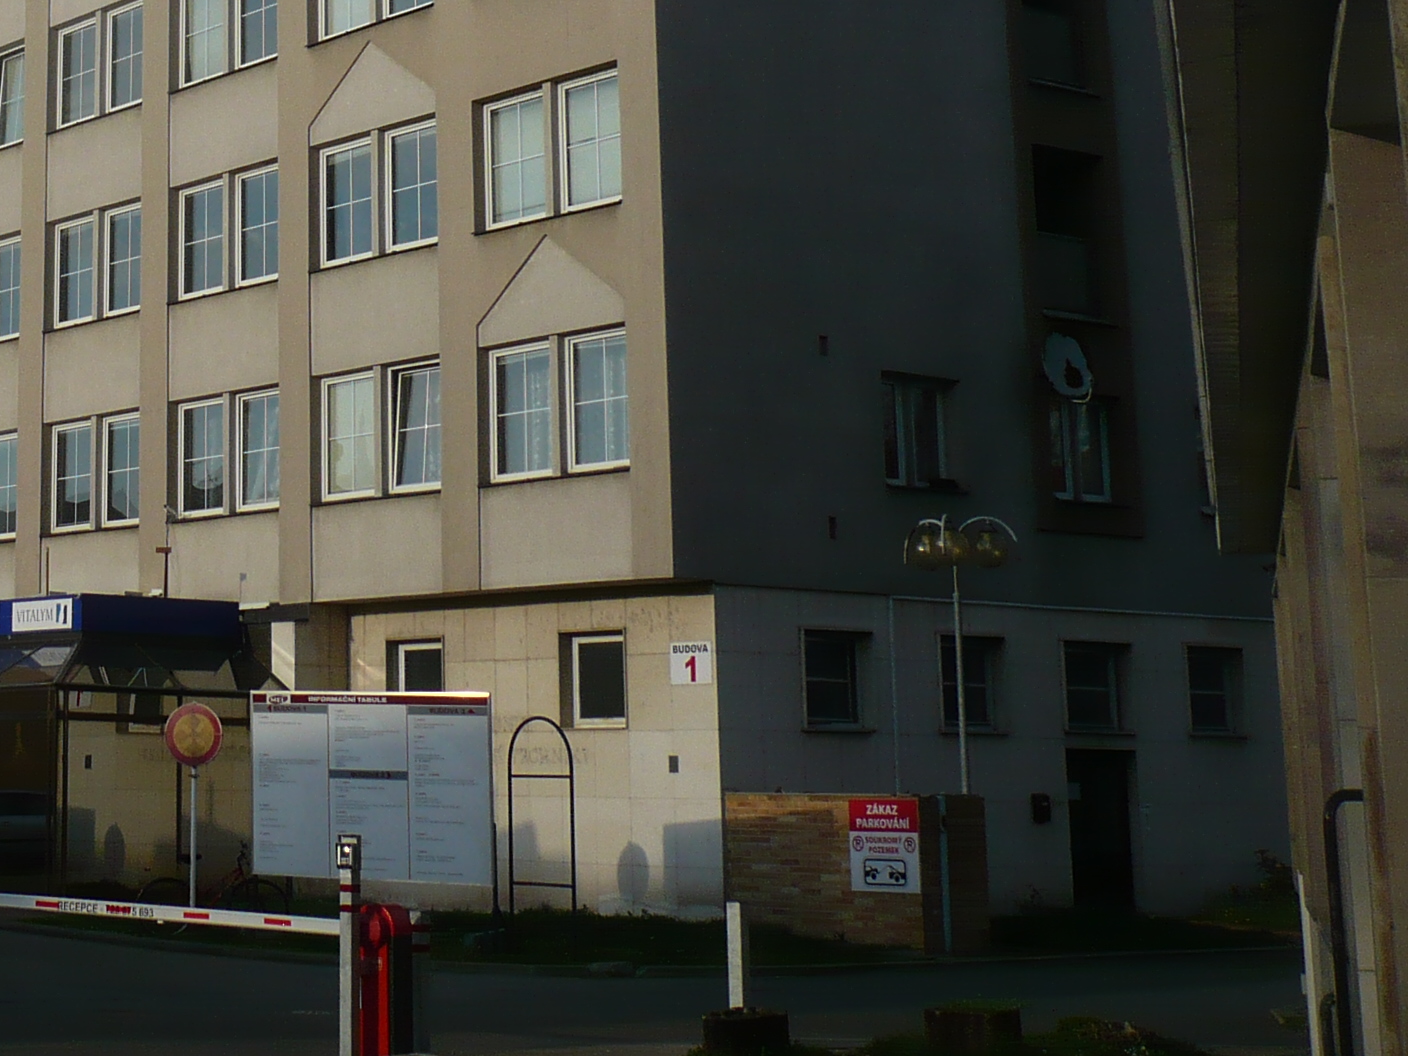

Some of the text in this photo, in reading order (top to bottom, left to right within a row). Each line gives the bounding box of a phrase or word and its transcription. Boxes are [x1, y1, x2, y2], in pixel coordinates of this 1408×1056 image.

[17, 608, 53, 623] VITALYM
[672, 644, 708, 654] BUDOVA
[685, 655, 696, 683] 1
[356, 696, 387, 704] TABULE
[865, 802, 899, 815] ZÁKAZ
[855, 817, 910, 830] PARKOVÁNÍ
[869, 846, 899, 854] POZEMEK
[59, 901, 98, 913] RECEPCE
